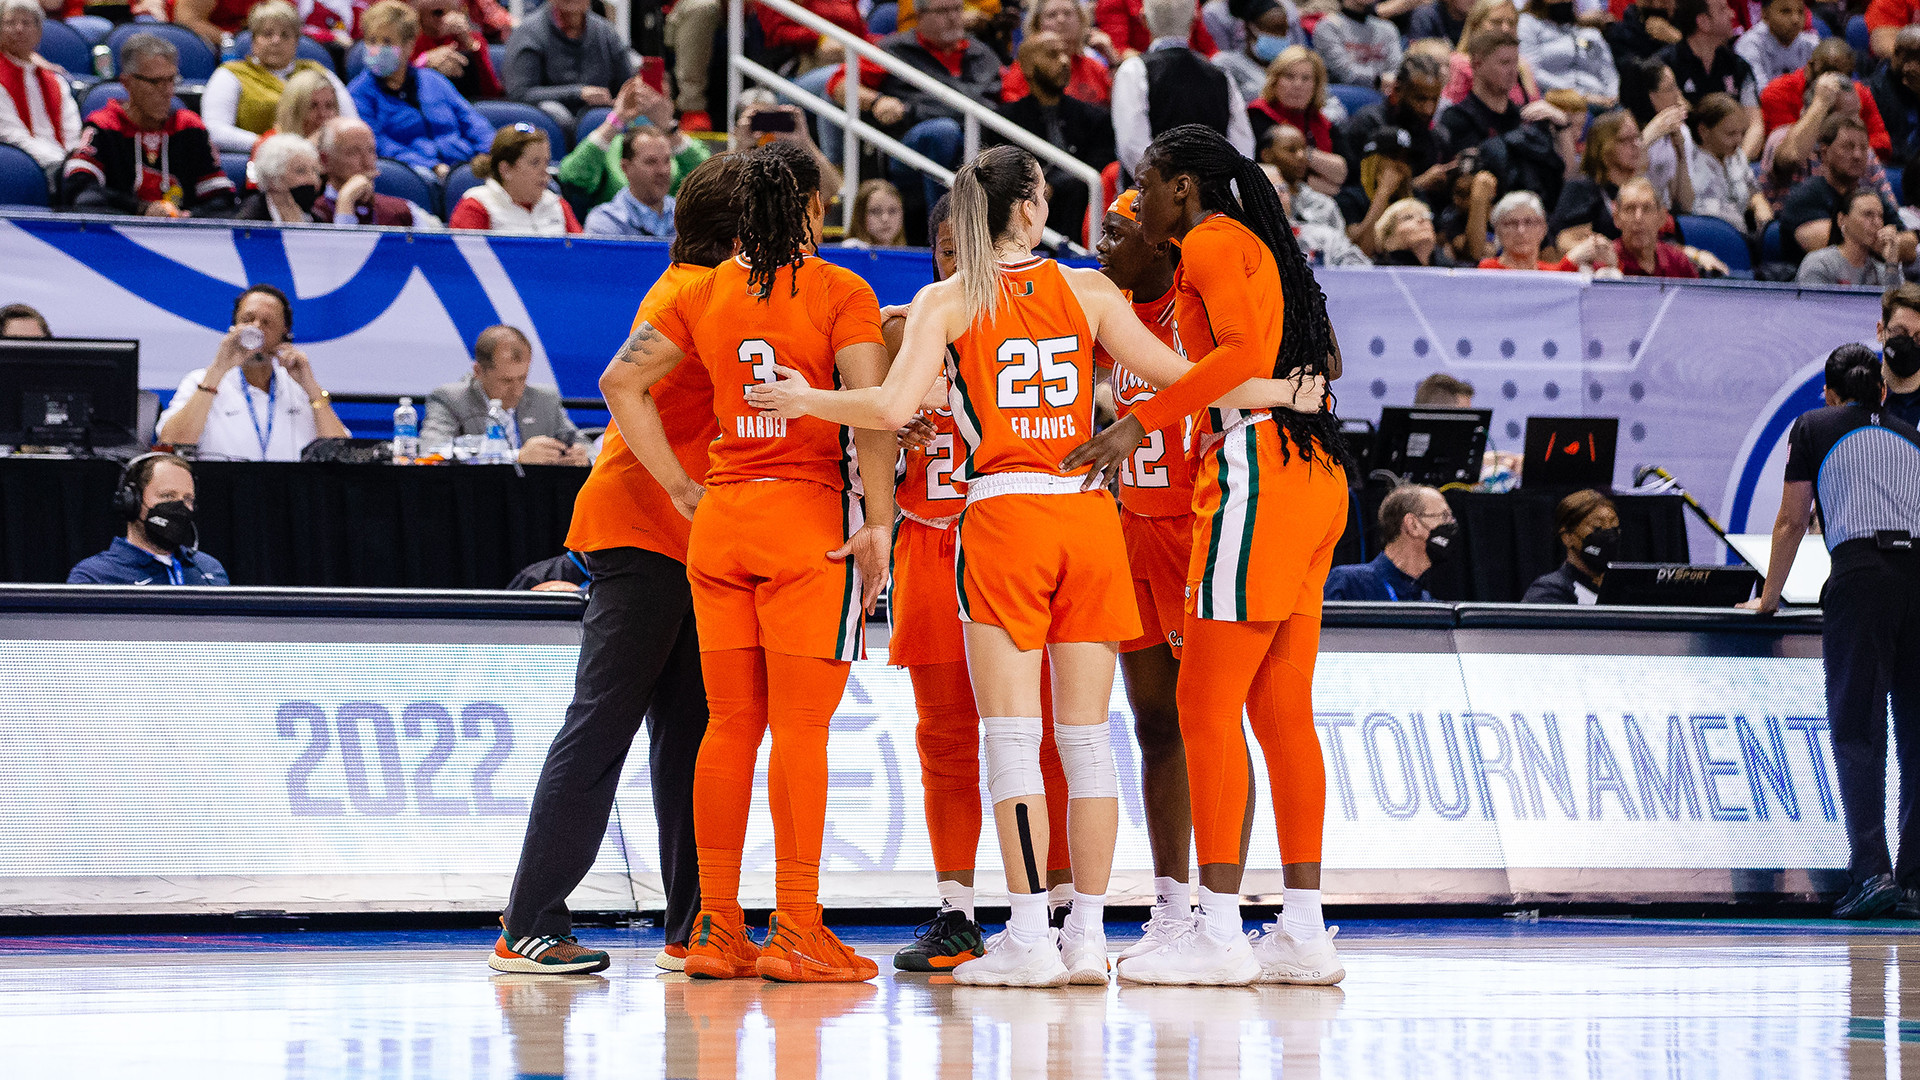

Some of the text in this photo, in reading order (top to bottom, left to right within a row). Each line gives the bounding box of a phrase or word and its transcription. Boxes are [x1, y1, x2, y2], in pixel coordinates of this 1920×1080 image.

[738, 338, 777, 396] 3
[997, 335, 1079, 408] 25
[737, 415, 787, 437] HARDEN
[1011, 414, 1076, 439] ERJAVEC
[276, 700, 1838, 821] 2022 TOURNAMENT
